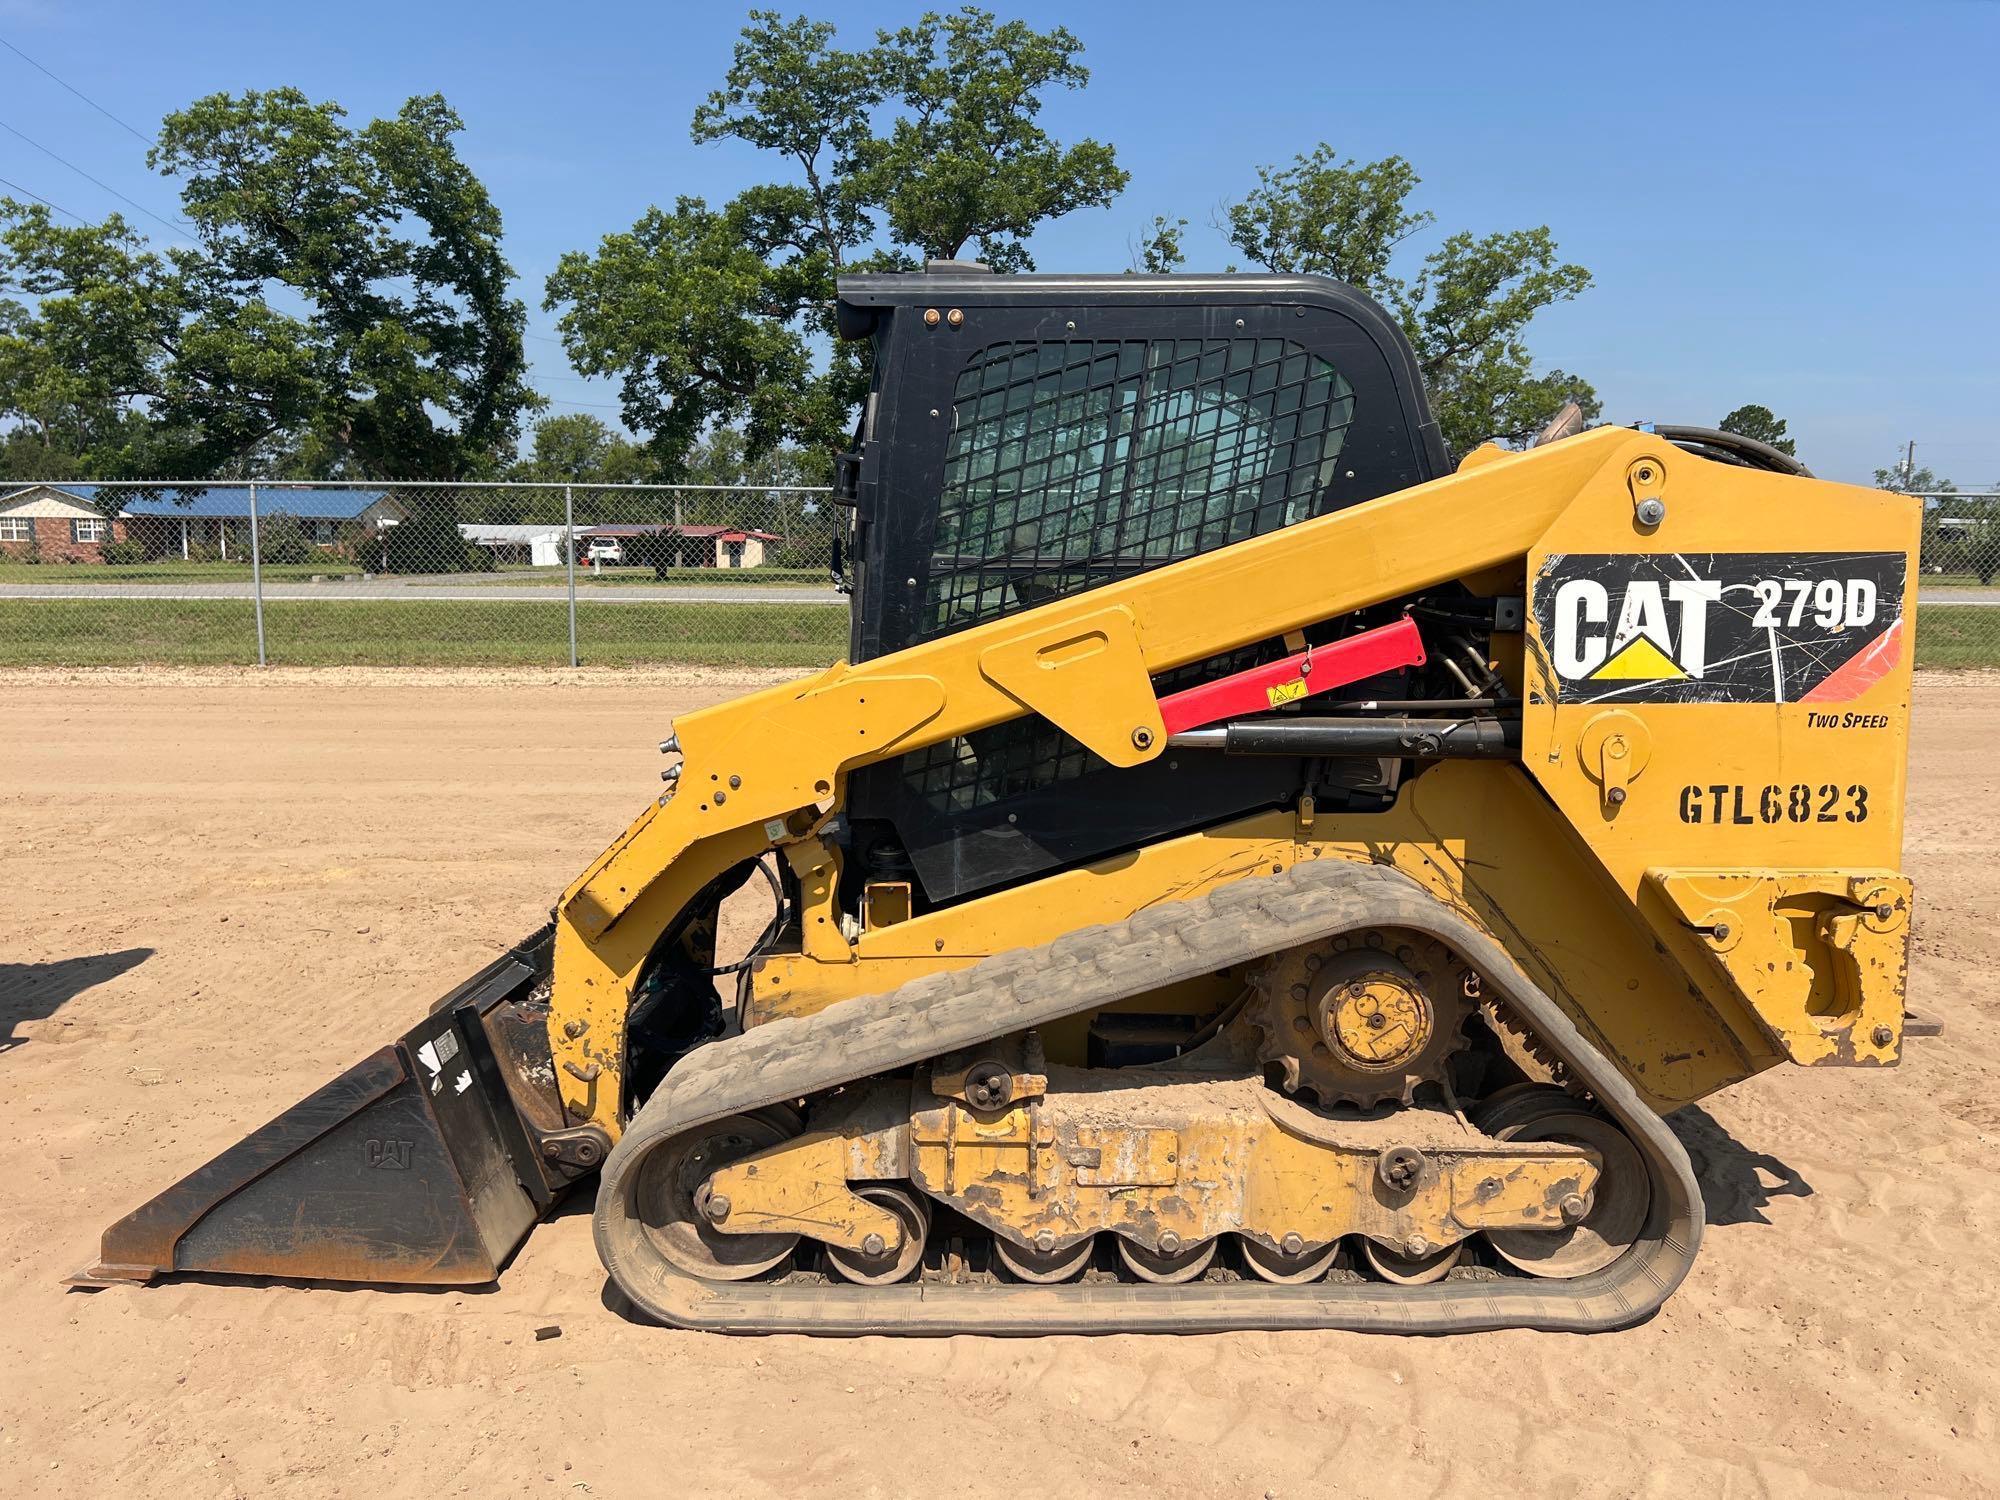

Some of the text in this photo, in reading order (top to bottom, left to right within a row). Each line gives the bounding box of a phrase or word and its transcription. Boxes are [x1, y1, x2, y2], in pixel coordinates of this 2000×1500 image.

[1753, 579, 1876, 628] 279D
[1555, 580, 1721, 679] CAT
[1680, 784, 1869, 825] GTL6823
[365, 1139, 414, 1169] CAT
